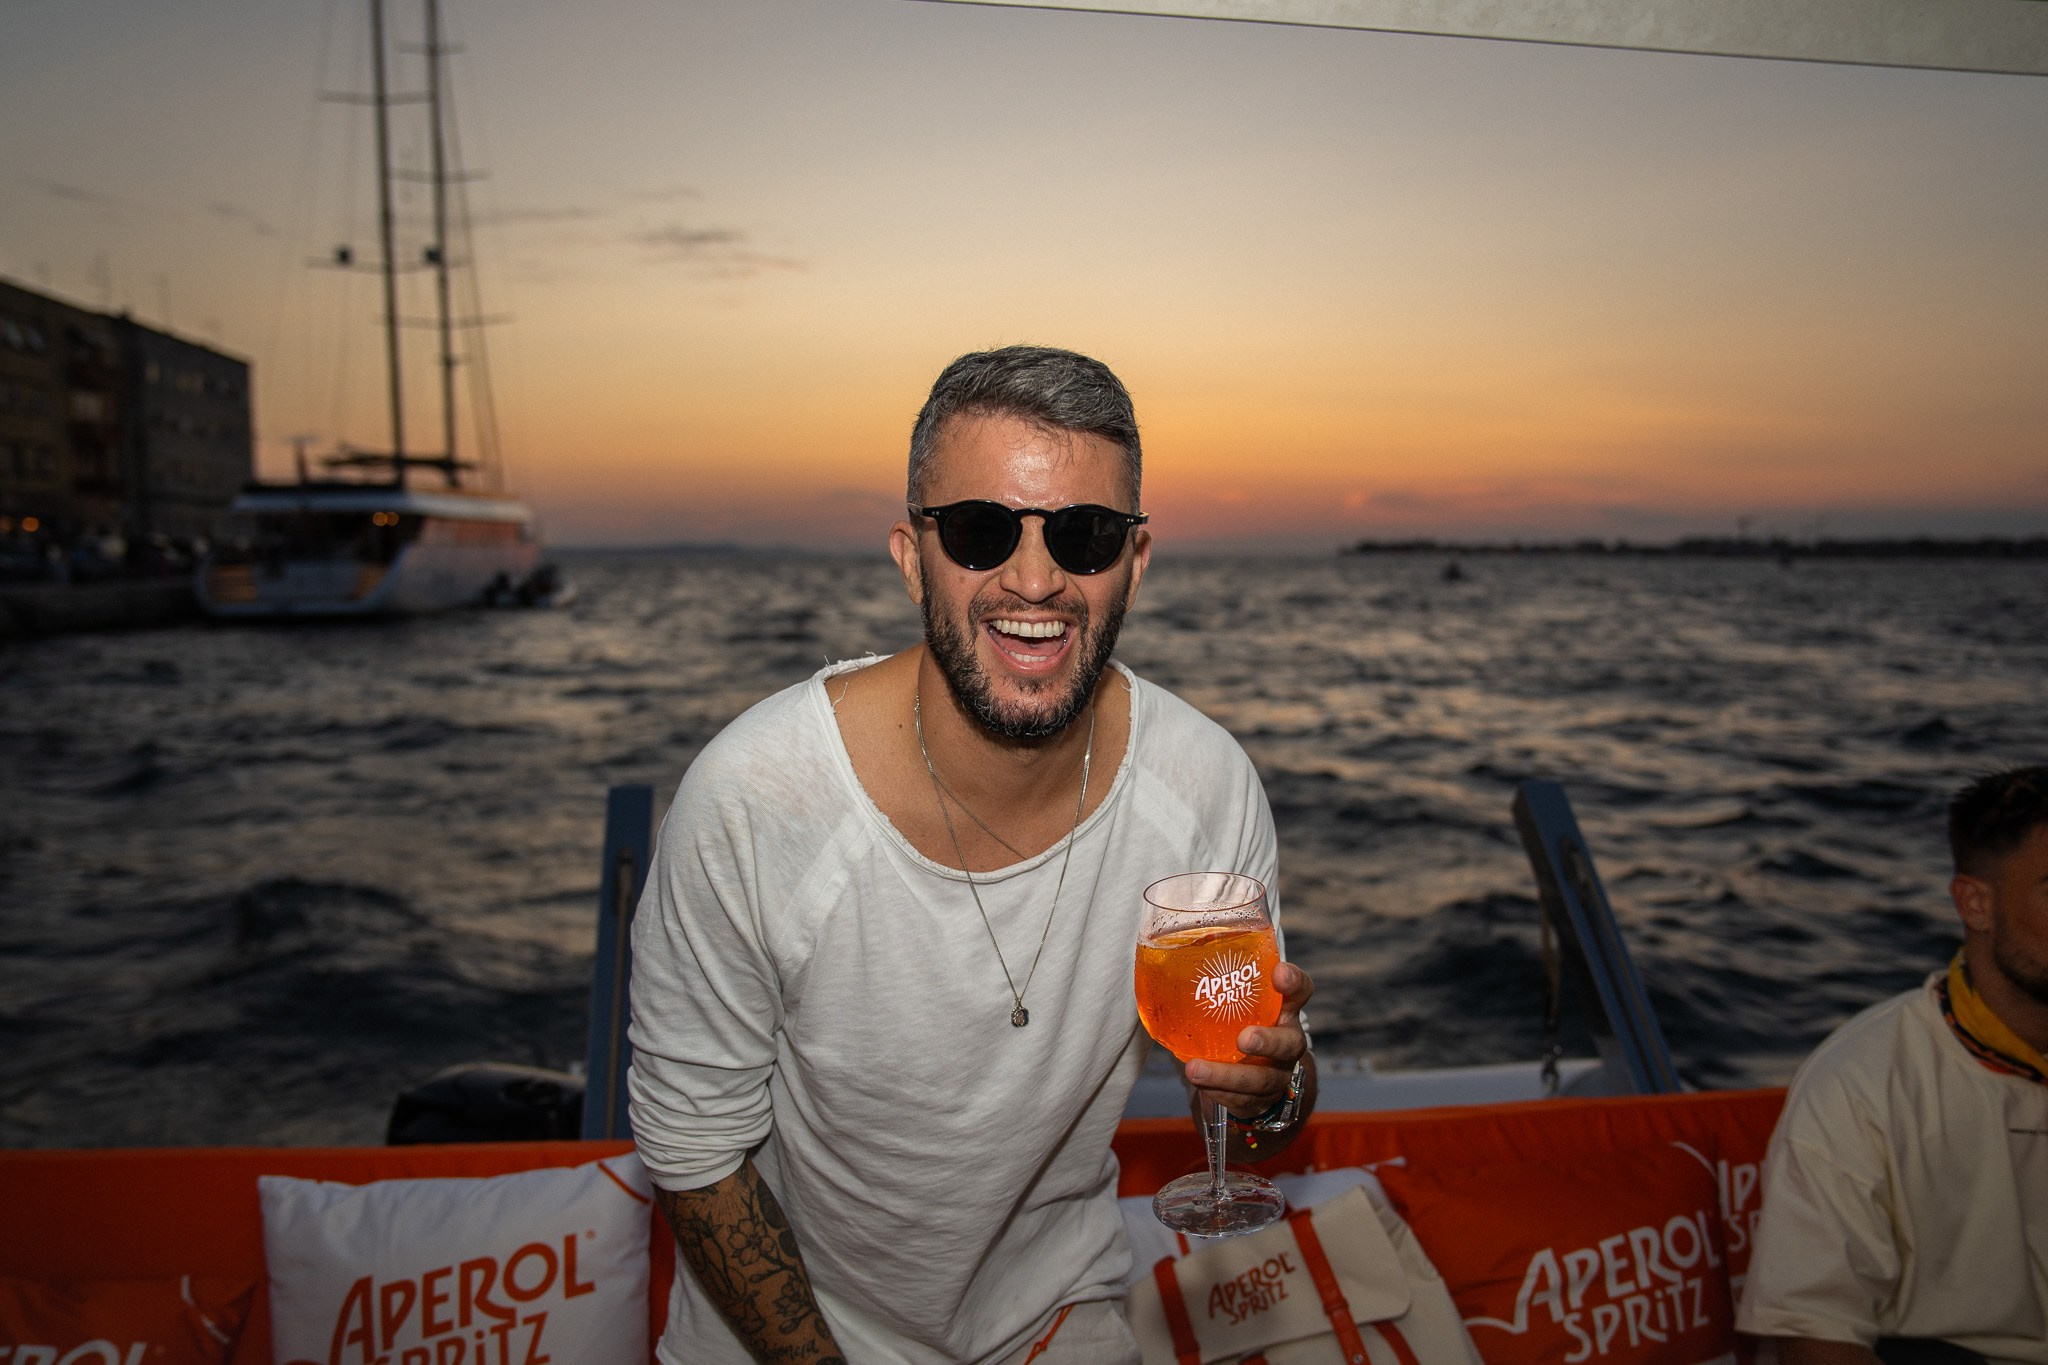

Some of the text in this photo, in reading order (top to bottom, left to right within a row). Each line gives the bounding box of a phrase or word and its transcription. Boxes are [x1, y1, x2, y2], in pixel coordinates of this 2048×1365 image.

[1195, 960, 1261, 1001] APEROL
[328, 1233, 596, 1365] APEROL
[1208, 1252, 1296, 1319] APEROL
[1513, 1209, 1721, 1336] APEROL
